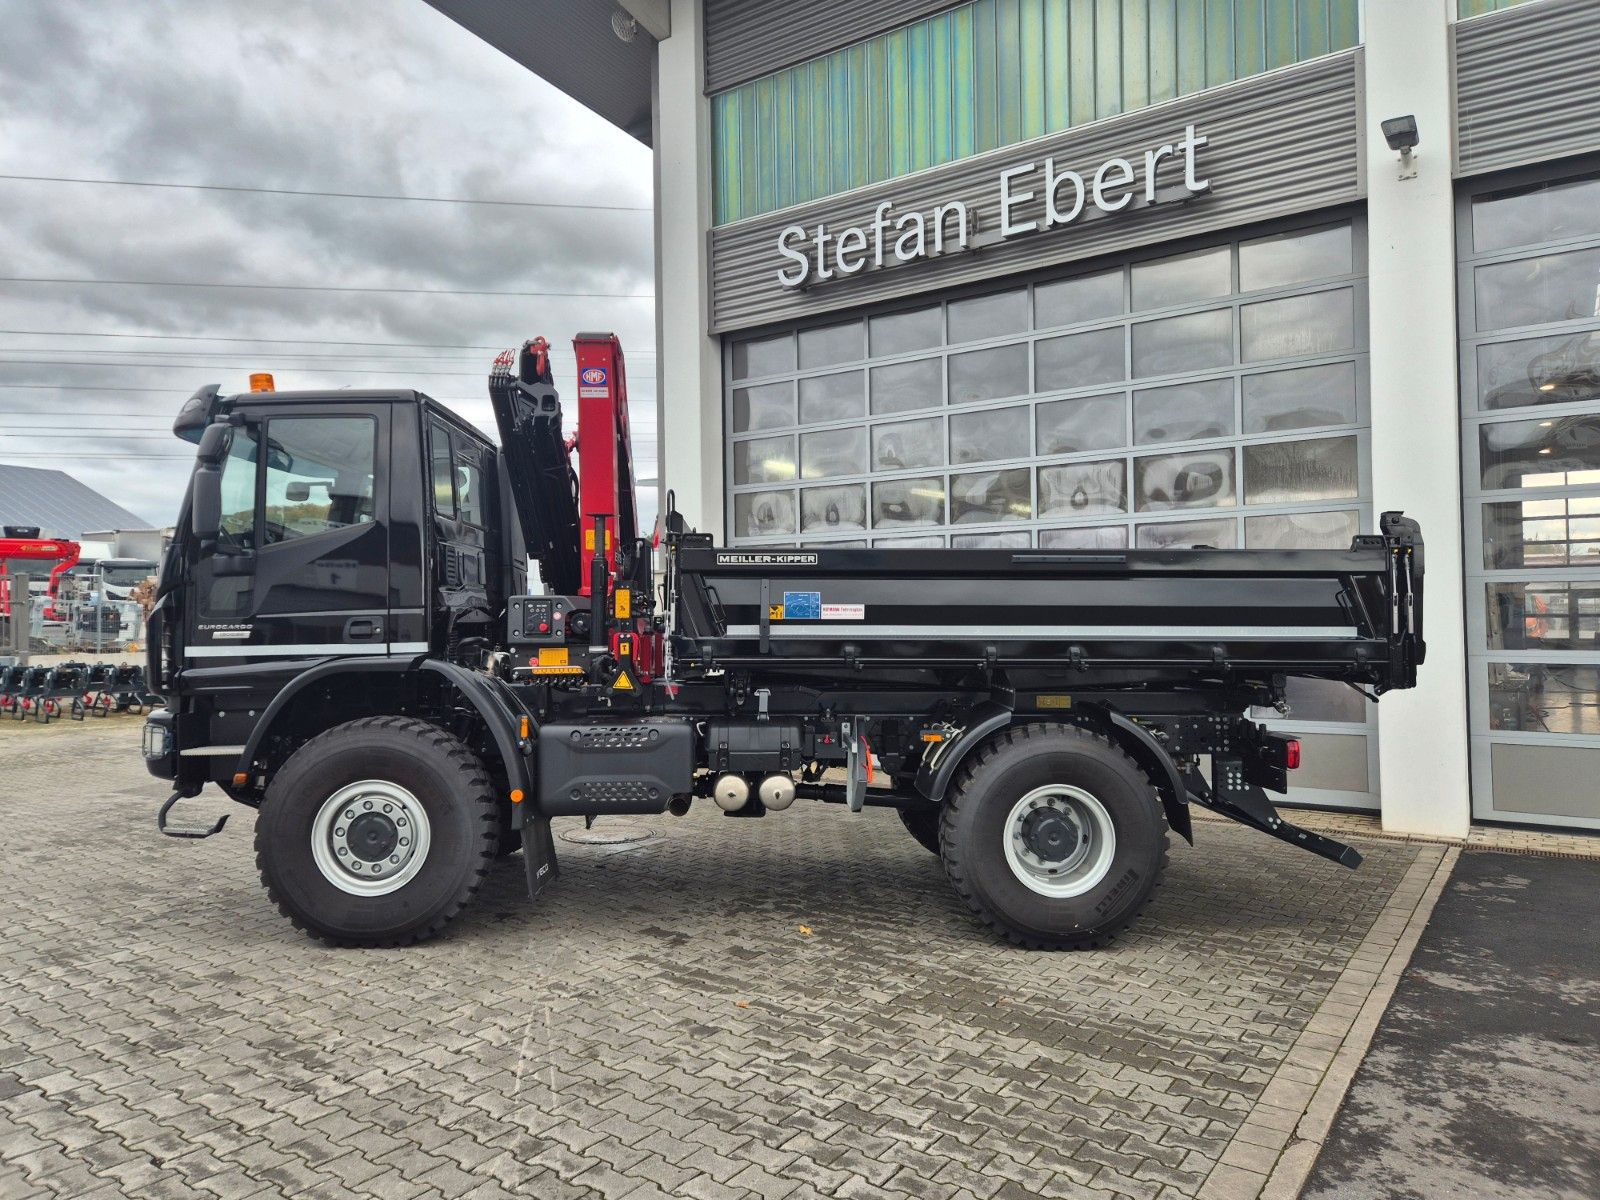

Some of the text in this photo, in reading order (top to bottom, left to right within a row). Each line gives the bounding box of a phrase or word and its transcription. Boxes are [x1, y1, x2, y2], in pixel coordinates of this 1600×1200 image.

[777, 124, 1211, 288] Stefan Ebert
[584, 370, 605, 382] HMF
[719, 555, 816, 564] MEILLER-KIPPER
